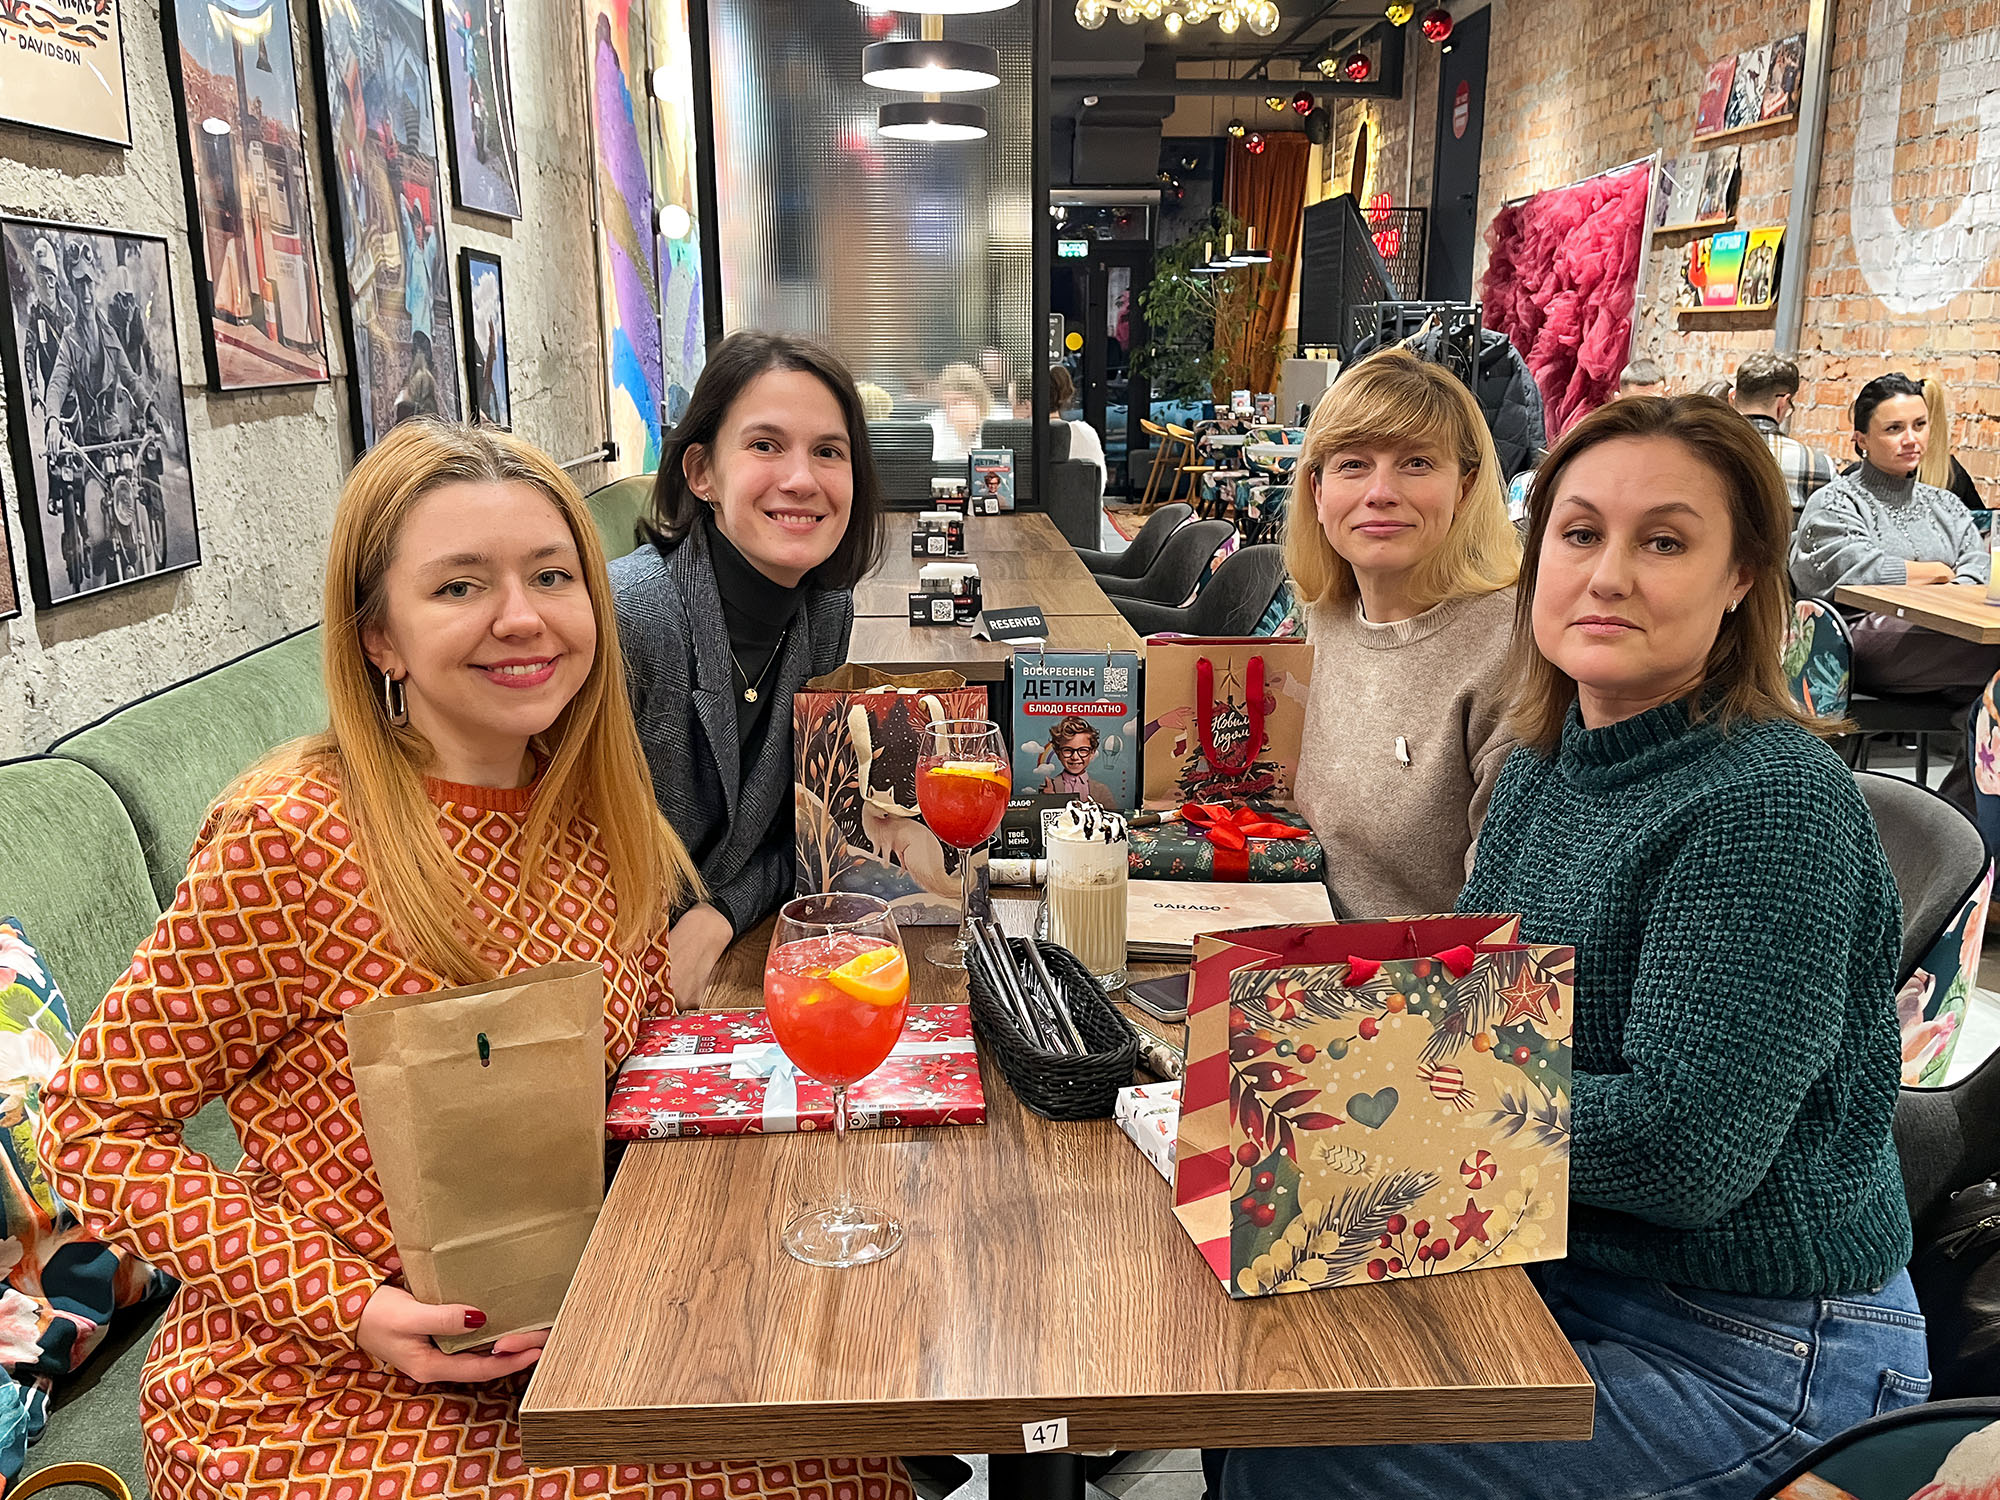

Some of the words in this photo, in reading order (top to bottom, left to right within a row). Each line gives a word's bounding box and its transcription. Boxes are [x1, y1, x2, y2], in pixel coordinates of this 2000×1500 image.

[989, 616, 1041, 630] RESERVED
[1023, 667, 1095, 676] ВОСКРЕСЕНЬЕ
[1023, 680, 1096, 699] ДЕТЯМ
[1029, 704, 1063, 714] БЛЮДО
[1065, 704, 1121, 713] БЕСПЛАТНО
[1008, 830, 1025, 838] ТВОЁ
[1032, 1423, 1059, 1444] 47
